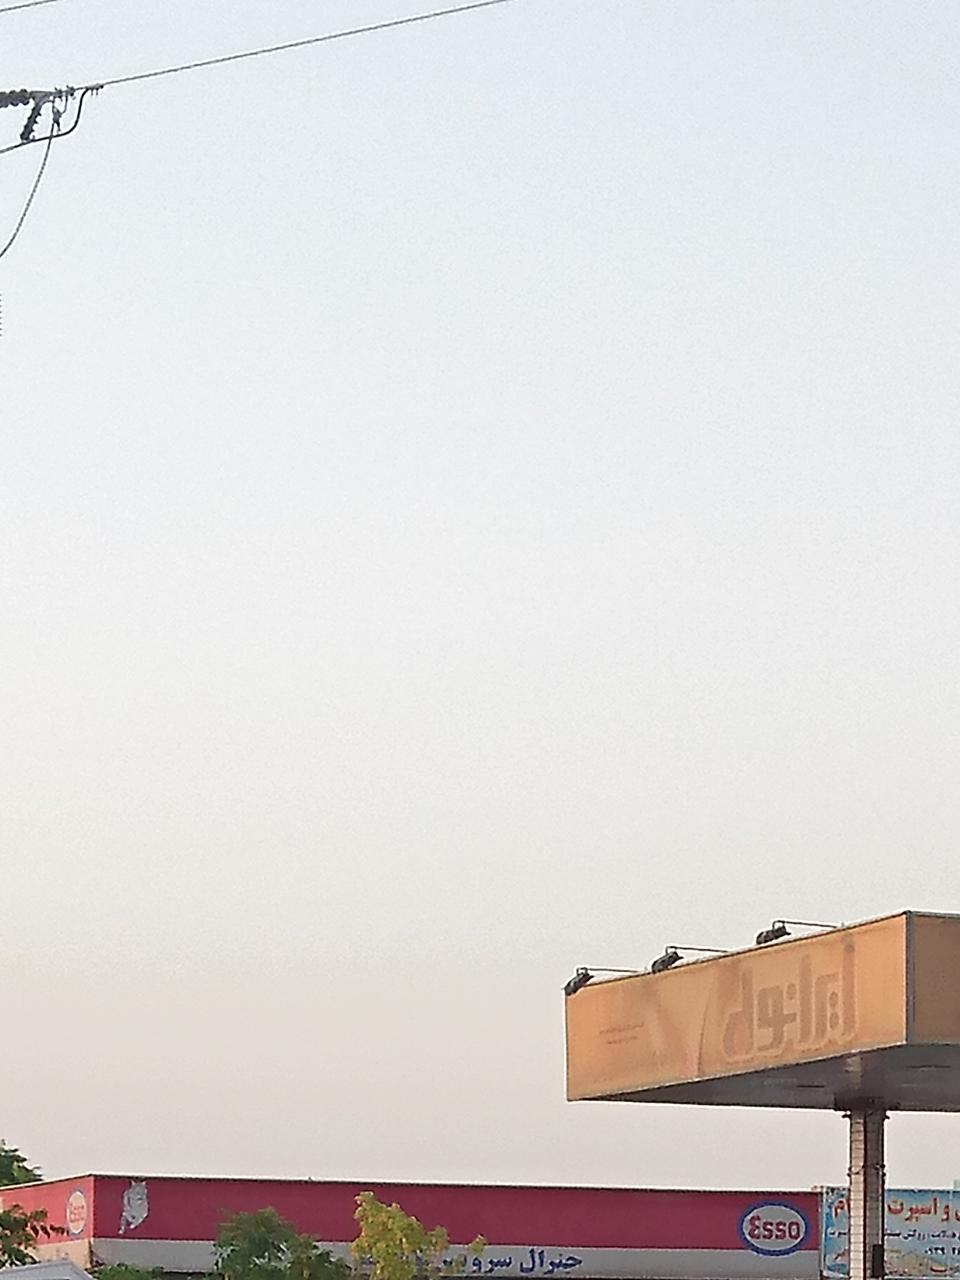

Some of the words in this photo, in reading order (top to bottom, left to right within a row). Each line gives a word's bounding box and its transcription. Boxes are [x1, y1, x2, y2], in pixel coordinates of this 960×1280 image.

[721, 943, 858, 1061] ایرانول
[748, 1214, 801, 1240] Esso
[519, 1248, 583, 1275] جنرال
